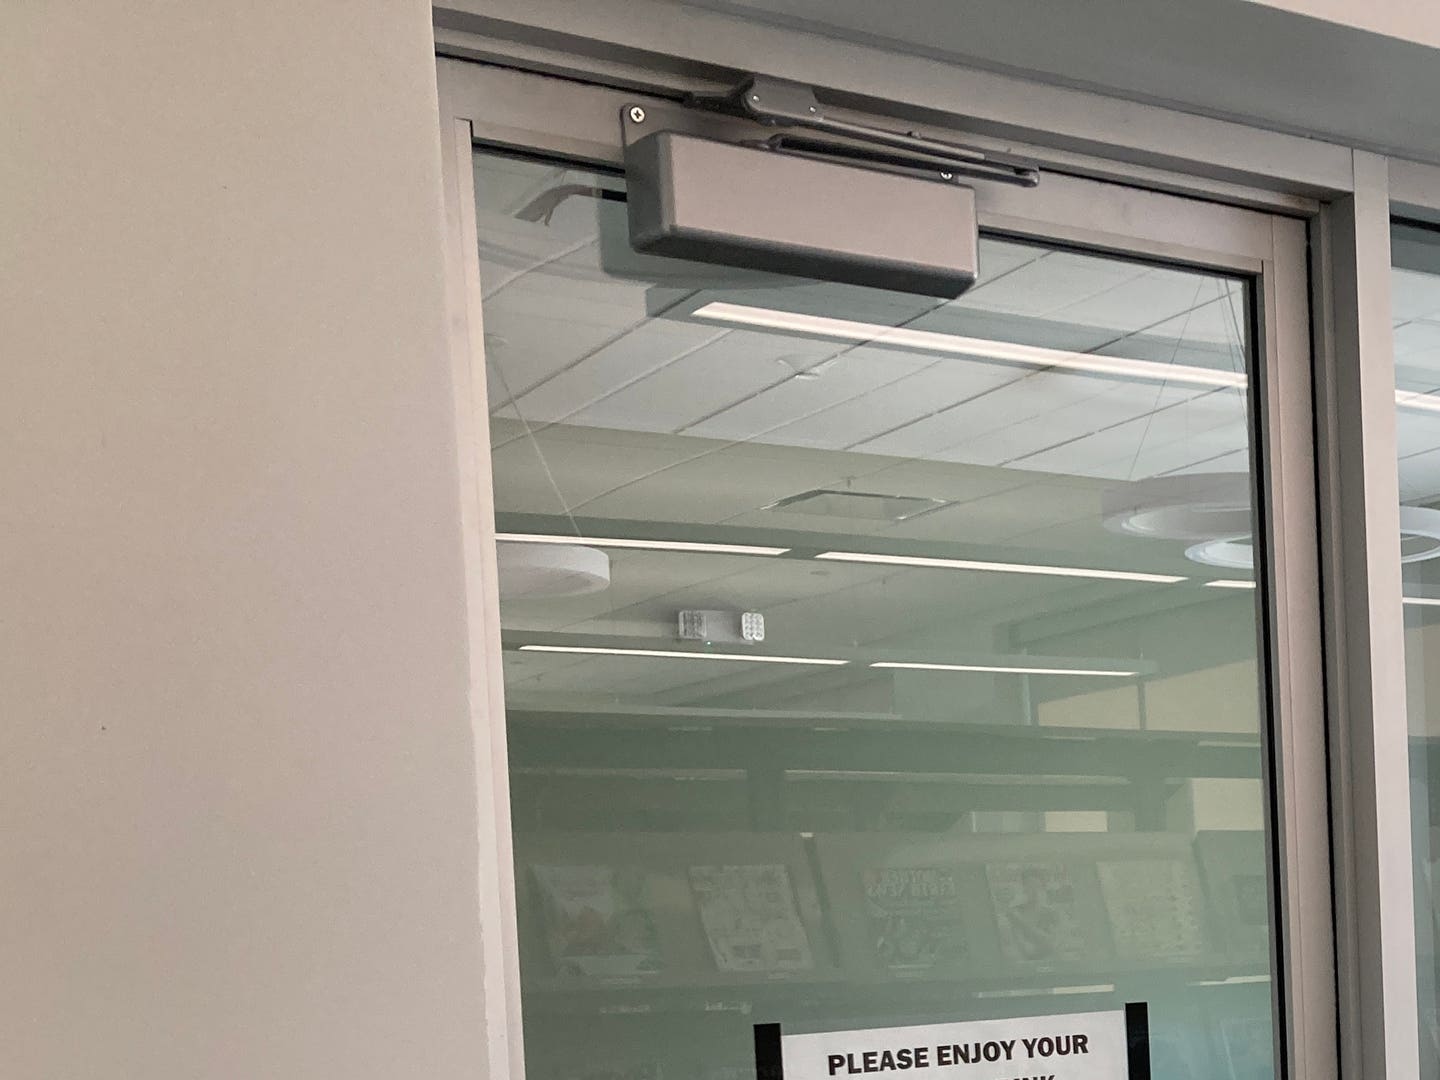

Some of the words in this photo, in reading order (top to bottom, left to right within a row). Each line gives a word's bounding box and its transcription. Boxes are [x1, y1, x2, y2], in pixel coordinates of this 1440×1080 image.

[828, 1047, 929, 1075] PLEASE
[937, 1040, 1016, 1066] ENJOY
[1022, 1034, 1089, 1059] YOUR
